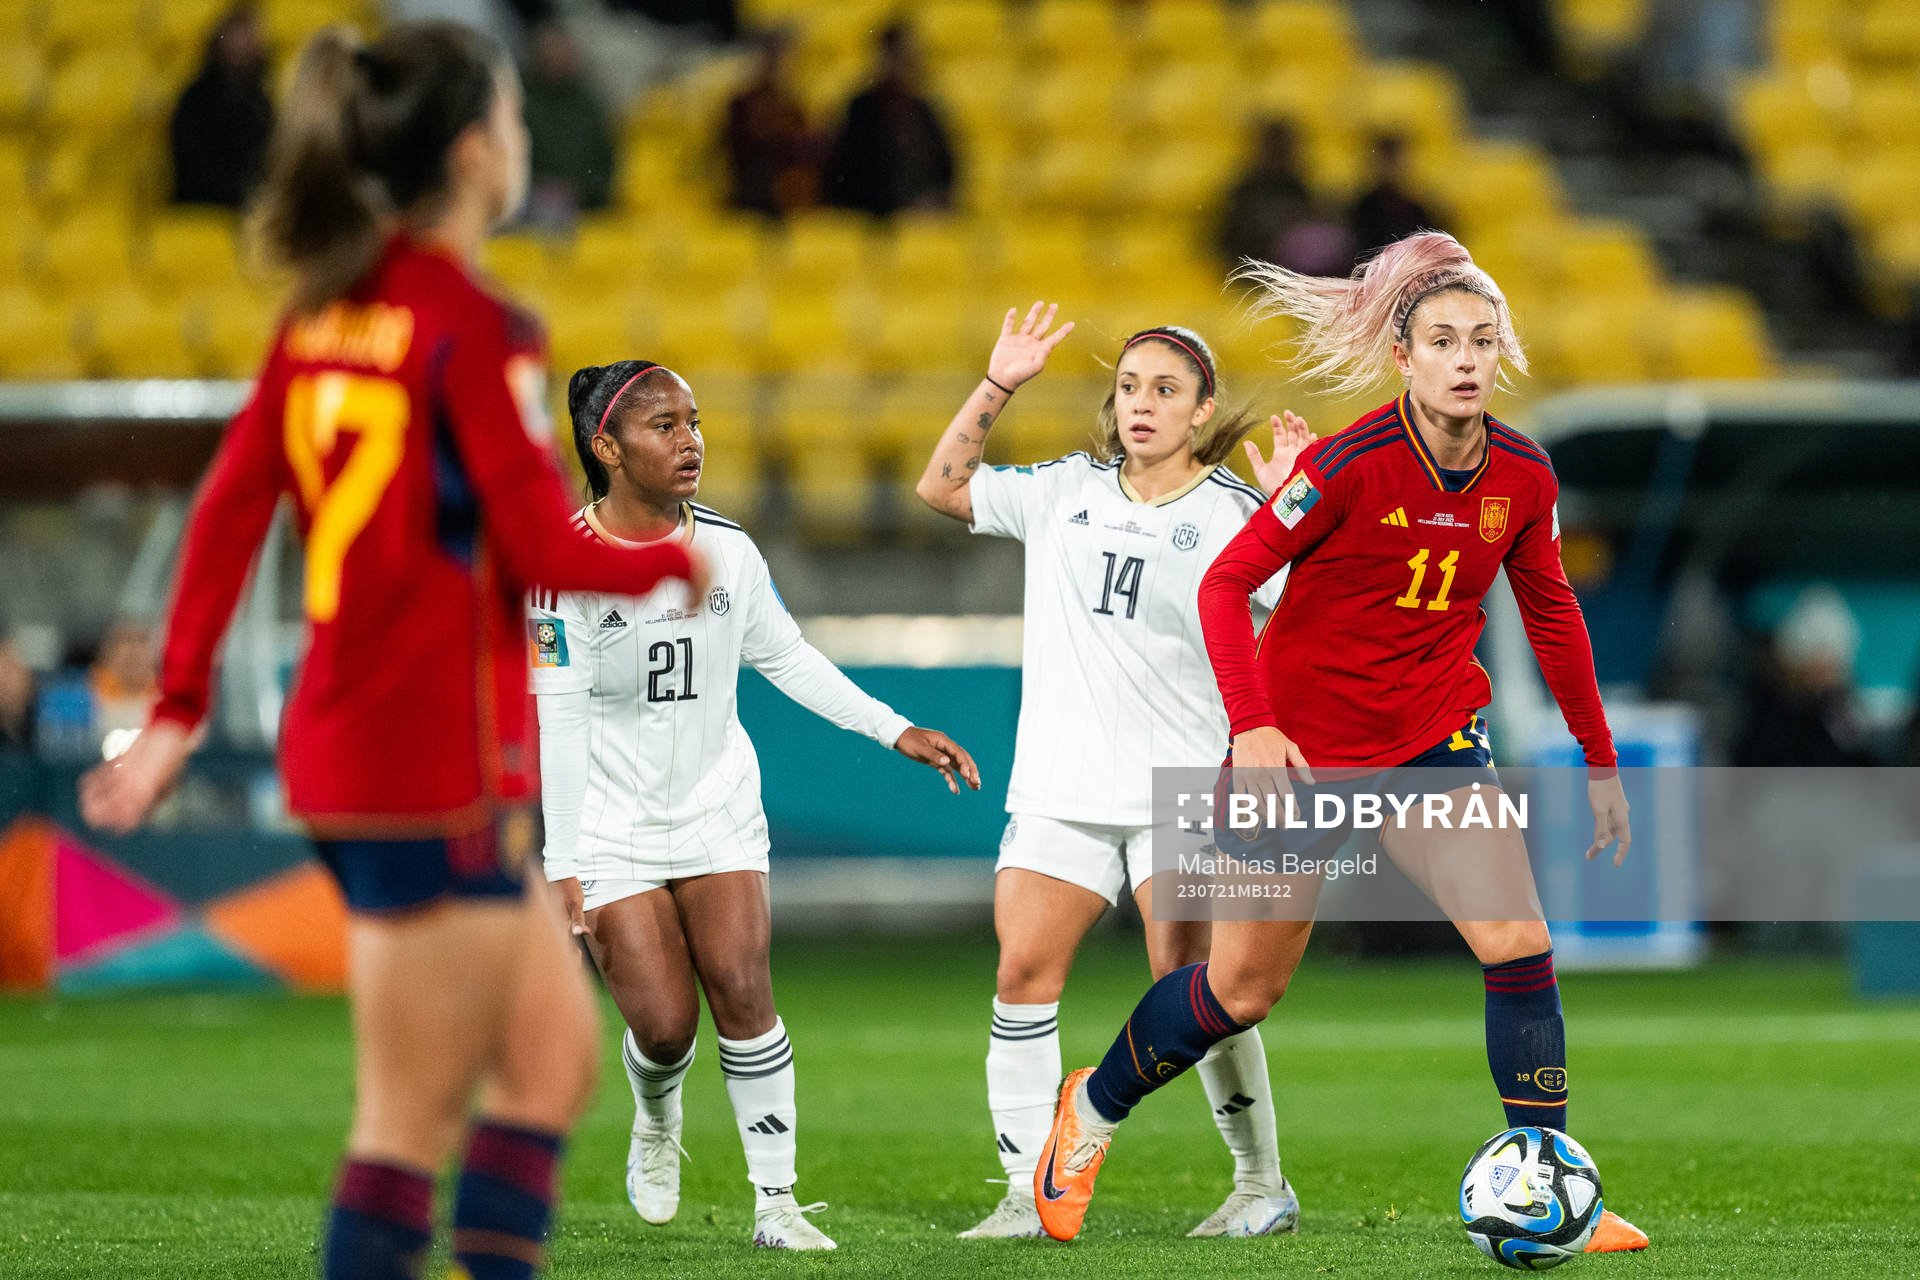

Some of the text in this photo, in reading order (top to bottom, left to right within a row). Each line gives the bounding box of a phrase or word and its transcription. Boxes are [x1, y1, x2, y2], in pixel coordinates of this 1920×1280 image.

[1092, 551, 1145, 620] 14
[1395, 548, 1460, 611] 11
[600, 620, 628, 629] adidas
[647, 637, 698, 702] 21
